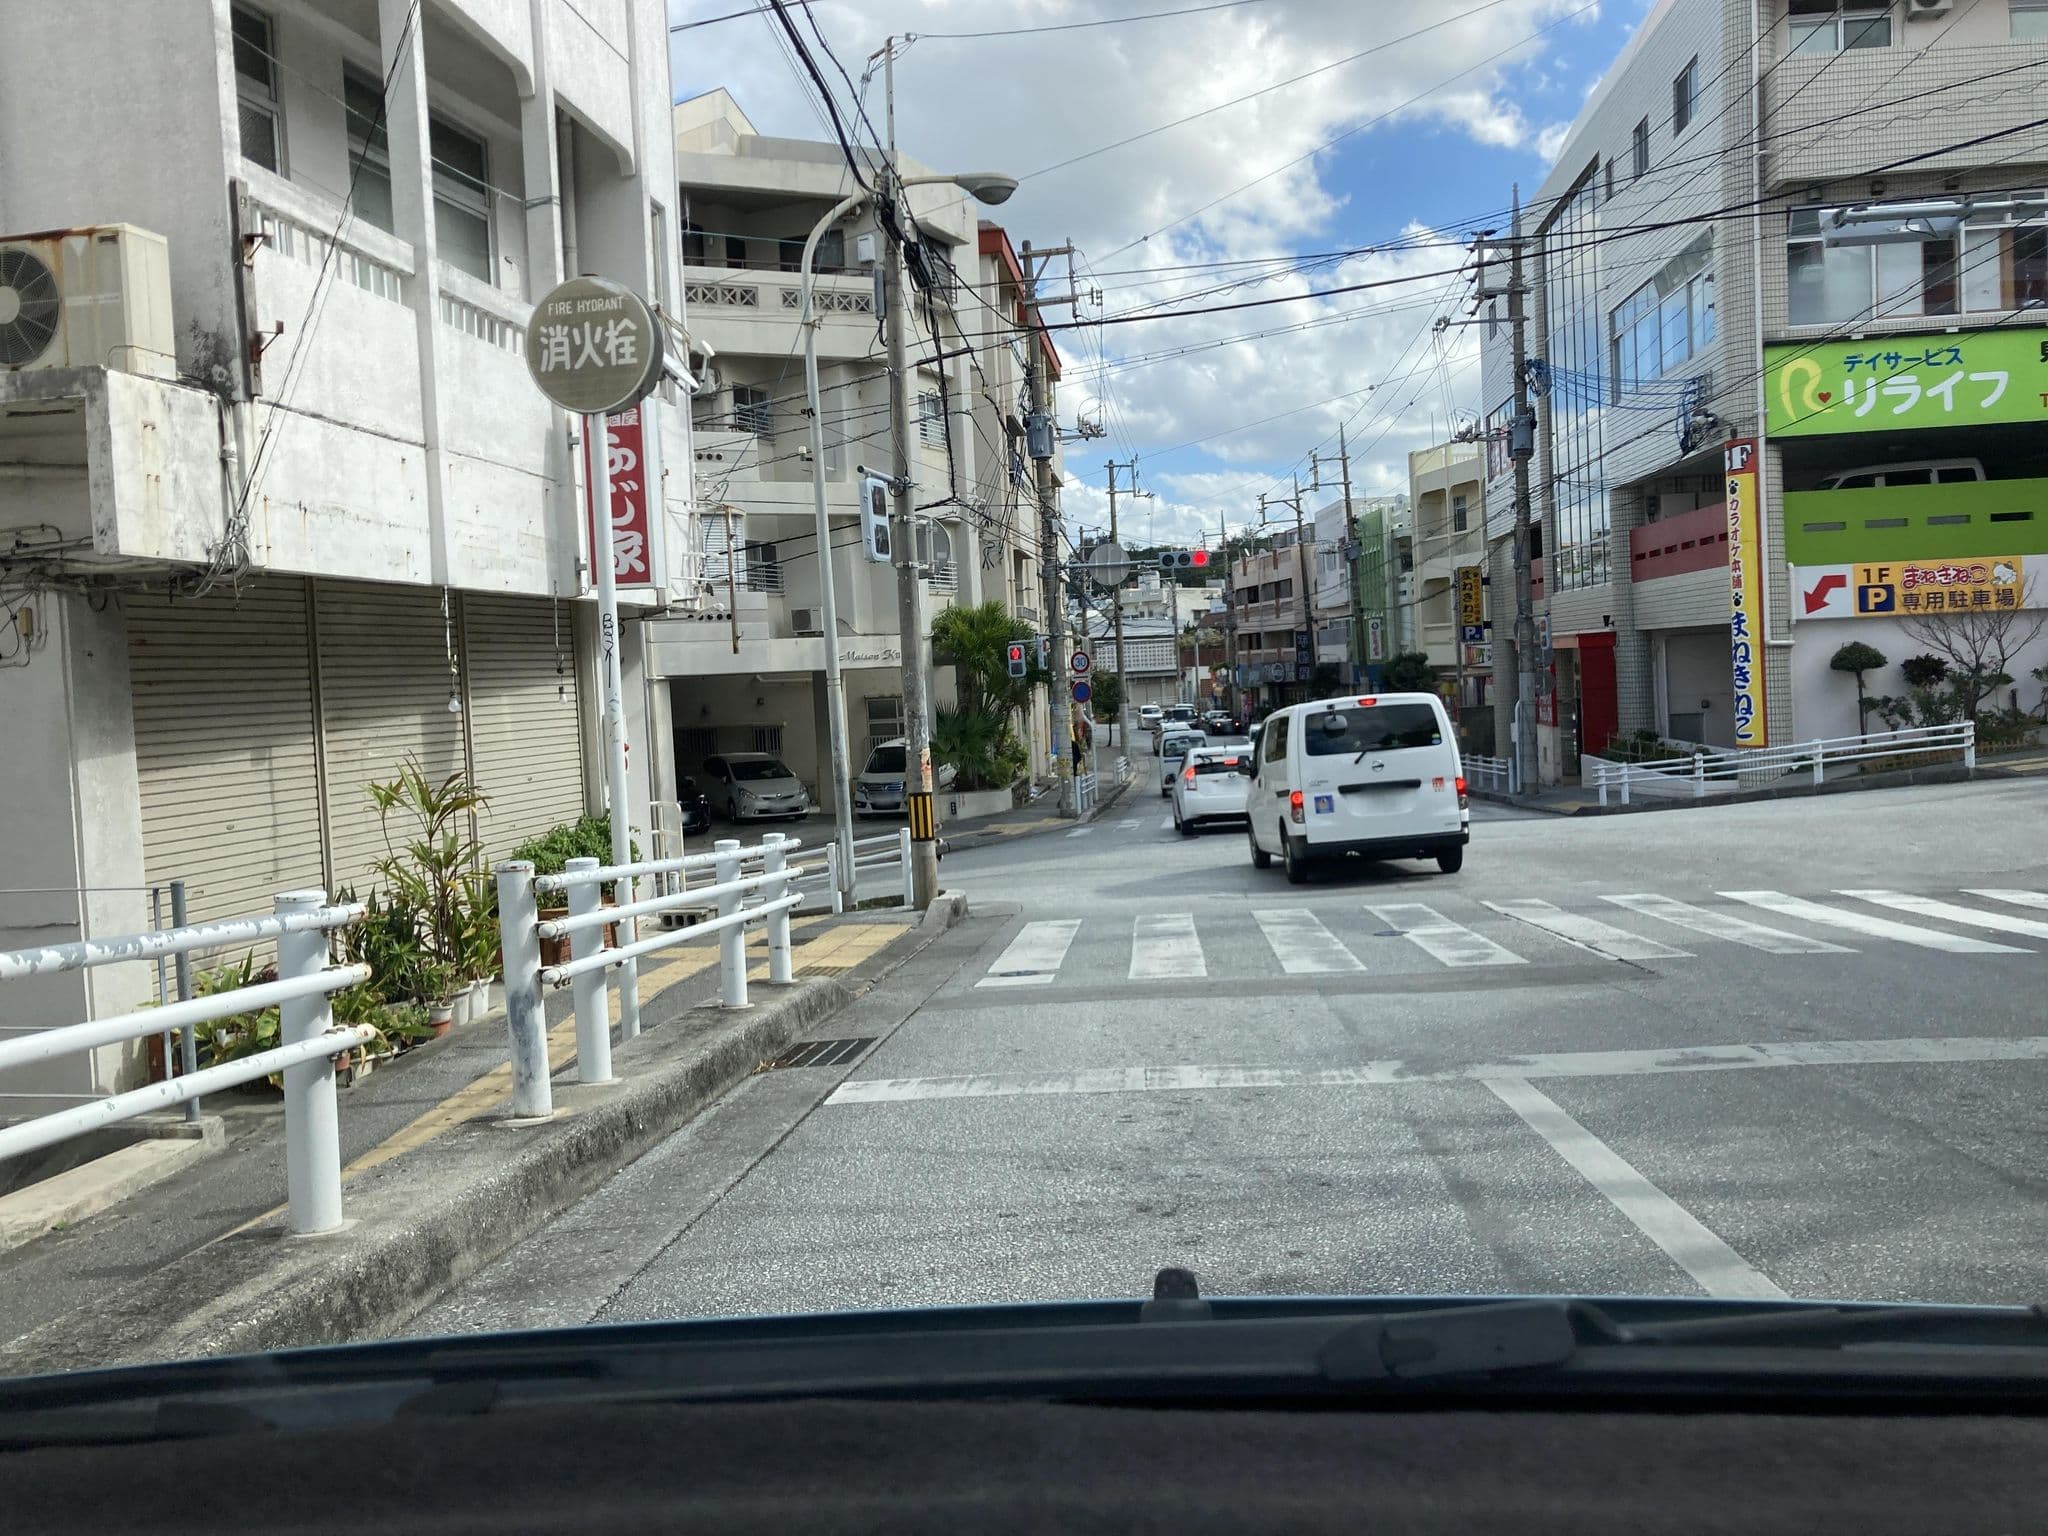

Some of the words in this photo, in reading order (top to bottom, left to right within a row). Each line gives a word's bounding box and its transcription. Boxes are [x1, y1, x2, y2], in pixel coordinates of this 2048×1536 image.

[548, 301, 573, 316] FIRE
[577, 297, 623, 313] HYDRANT
[540, 318, 638, 373] 消火栓
[1843, 347, 1964, 373] デイサービス
[1844, 370, 2009, 417] リライフ
[1729, 498, 1743, 590] カラオケ本舗
[1863, 568, 1889, 583] 1F
[1902, 564, 1988, 589] まねきねこ
[1867, 587, 1888, 610] P
[1902, 588, 2015, 610] 専用駐車場
[1074, 655, 1086, 668] 30
[1731, 611, 1753, 739] まねきねこ
